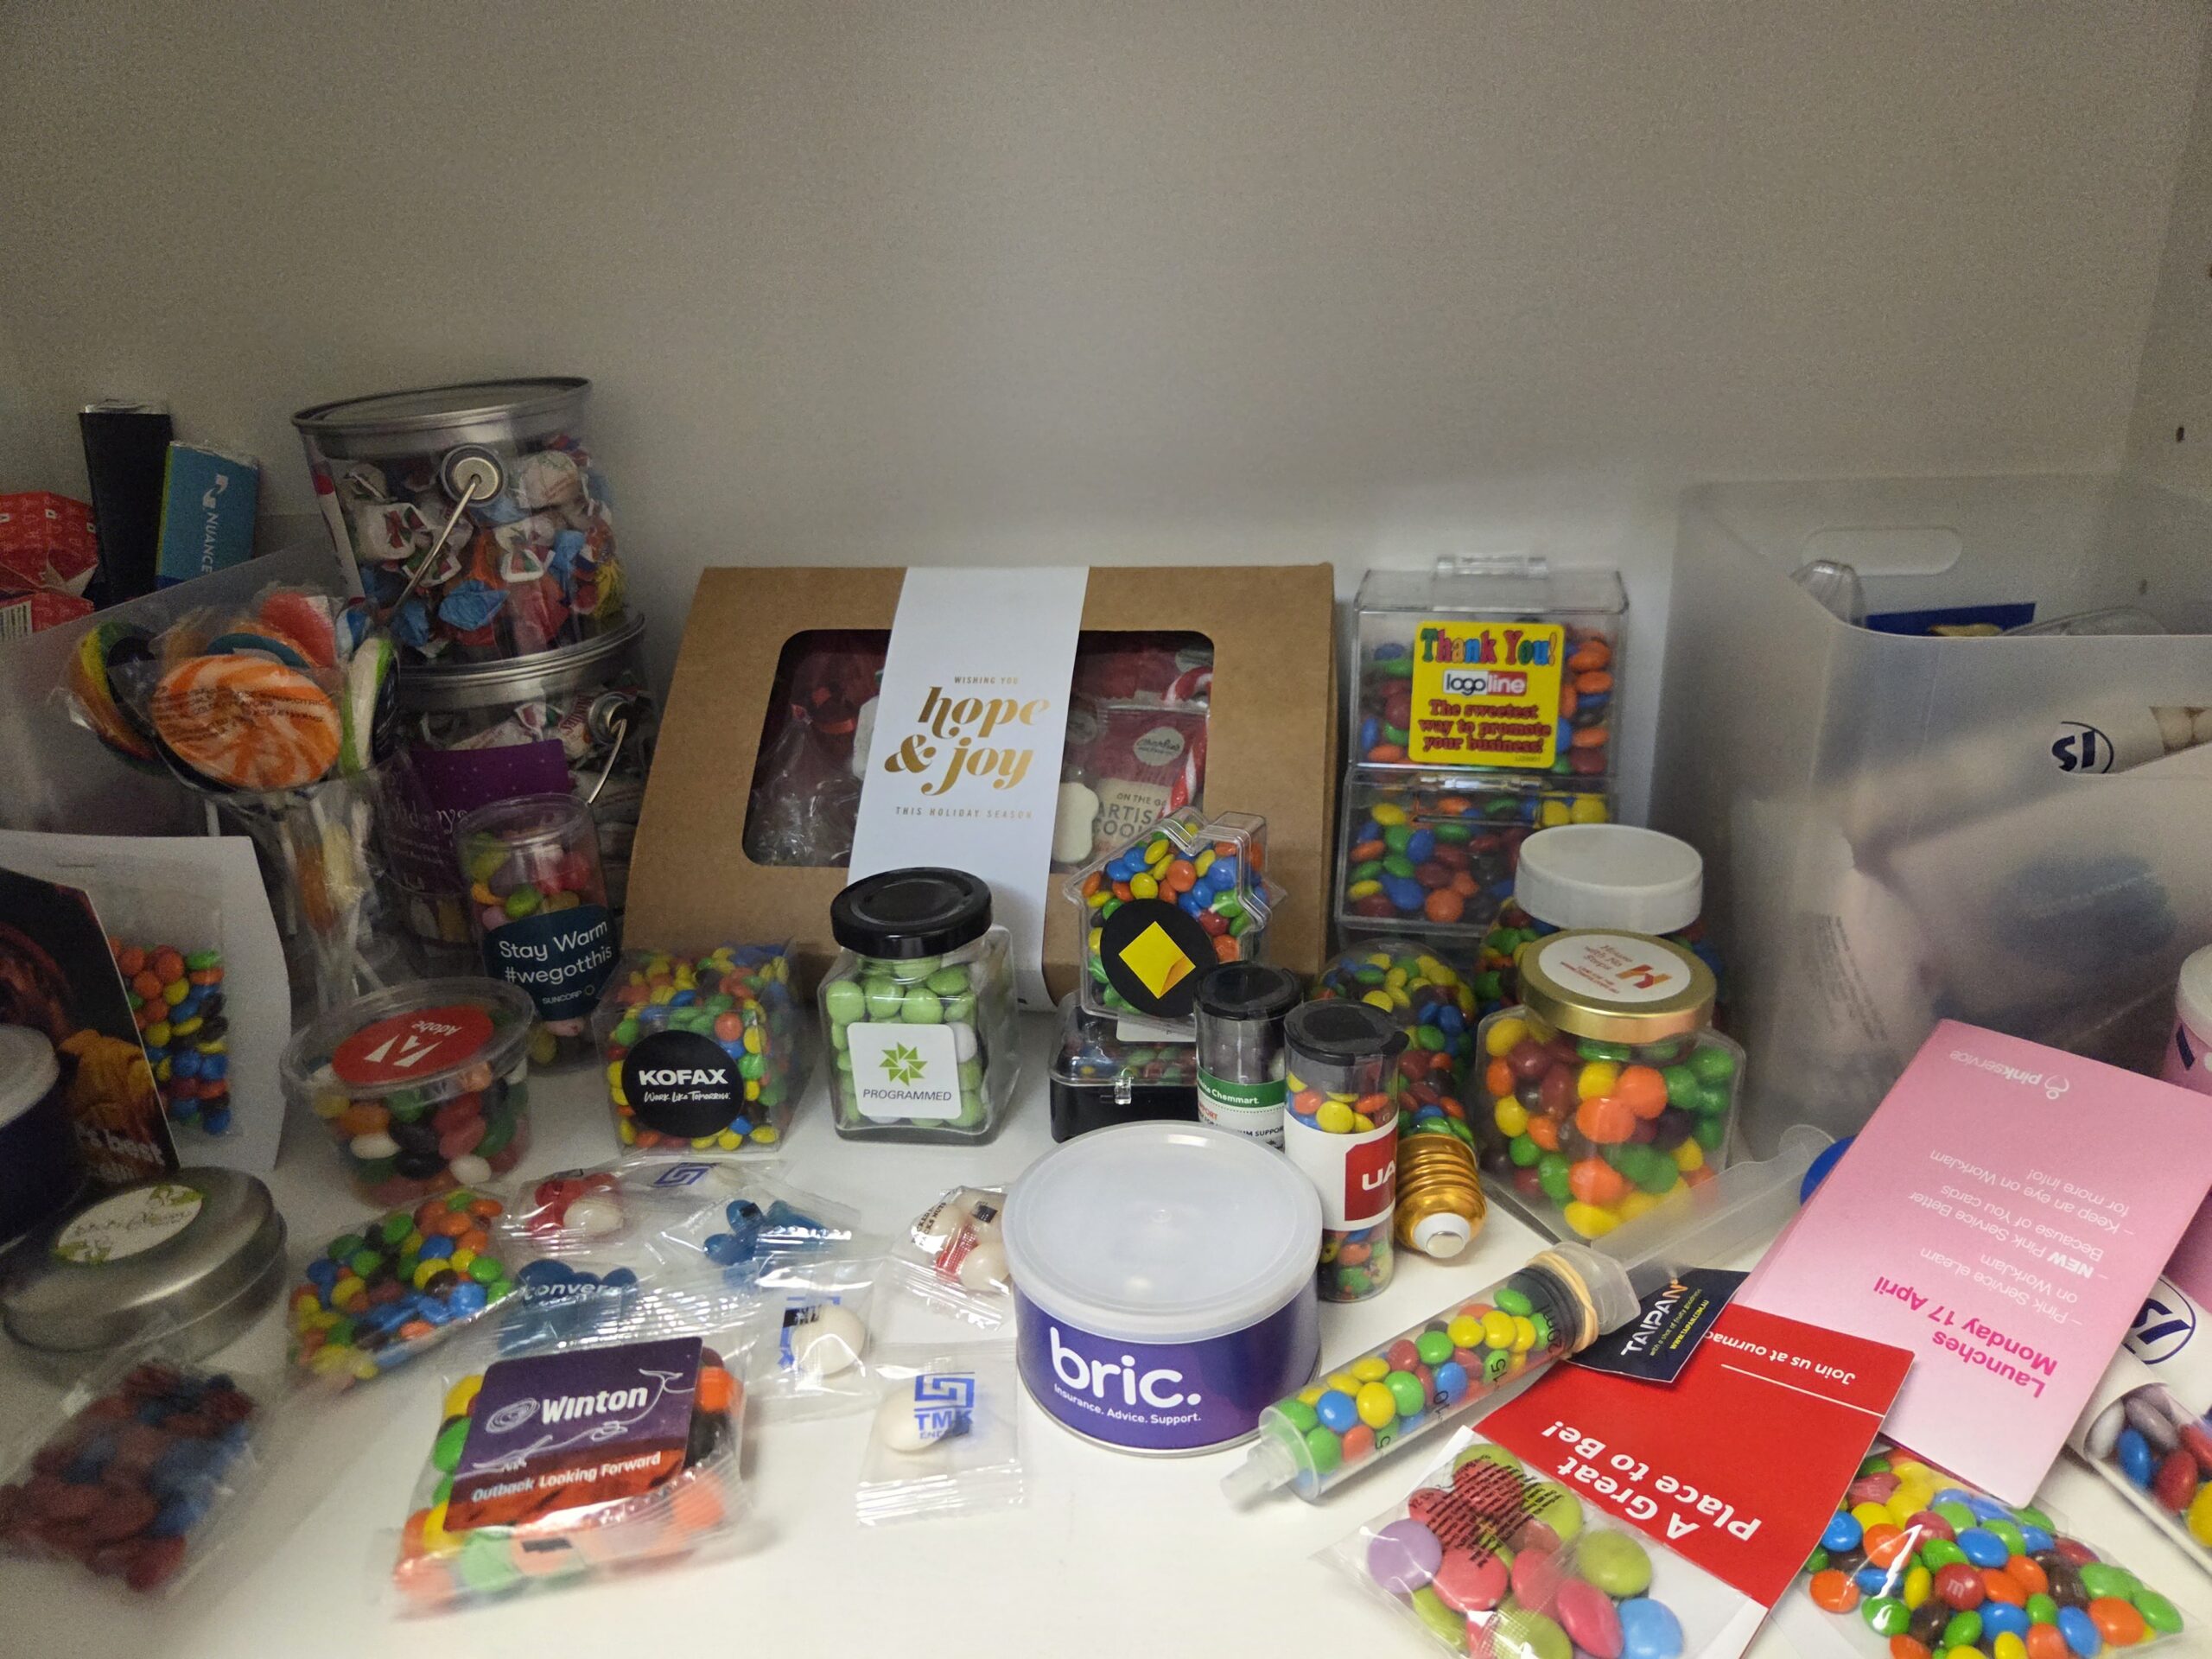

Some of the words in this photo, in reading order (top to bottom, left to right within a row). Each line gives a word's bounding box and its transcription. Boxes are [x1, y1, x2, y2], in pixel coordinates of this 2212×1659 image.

[201, 512, 219, 574] NUANCE
[1421, 628, 1497, 664] Thank
[1503, 630, 1557, 666] You!
[1001, 677, 1020, 685] YOU
[1446, 674, 1526, 696] logoline
[918, 686, 1051, 740] hope
[1428, 699, 1461, 716] The
[1464, 703, 1539, 719] sweetest
[1418, 720, 1454, 736] way
[1457, 719, 1475, 734] to
[1478, 722, 1552, 738] promote
[1423, 736, 1464, 753] your
[884, 734, 937, 773] &
[921, 737, 1034, 796] joy
[1116, 792, 1131, 801] ON
[1133, 794, 1151, 804] THE
[896, 806, 922, 816] THIS
[930, 808, 980, 818] HOLIDAY
[987, 810, 1033, 819] SEASON
[499, 940, 549, 962] Stay
[553, 921, 607, 952] Warm
[505, 945, 613, 985] #wegotthis
[542, 990, 582, 1005] SUNCORP
[411, 1020, 462, 1037] Adobe
[639, 1069, 728, 1085] KOFAX
[1949, 1050, 2043, 1085] pinkservice
[863, 1089, 951, 1101] PROGRAMMED
[1929, 1149, 1996, 1185] WorkJam
[2026, 1168, 2061, 1190] info!
[1941, 1185, 1981, 1207] cards
[2000, 1176, 2020, 1192] on
[2024, 1186, 2050, 1205] eye
[2063, 1182, 2105, 1205] more
[1908, 1191, 1953, 1217] Better
[1986, 1203, 2011, 1224] You
[2054, 1198, 2074, 1213] an
[2108, 1201, 2130, 1217] for
[1955, 1210, 2010, 1242] Service
[2013, 1216, 2031, 1229] of
[2077, 1208, 2120, 1235] Keep
[2012, 1234, 2047, 1258] Pink
[2035, 1224, 2104, 1262] Because
[1920, 1247, 1971, 1277] eLearn
[1980, 1253, 2053, 1296] WorkJam
[2047, 1251, 2094, 1279] NEW
[1873, 1276, 1929, 1311] April
[1974, 1272, 2030, 1306] Service
[2056, 1287, 2078, 1304] on
[1620, 1279, 1688, 1356] TAIPAN
[1928, 1306, 1955, 1326] 17
[2032, 1300, 2069, 1325] Pink
[1769, 1349, 1789, 1363] at
[1961, 1318, 2058, 1376] Monday
[1050, 1326, 1202, 1408] bric.
[1491, 1358, 1508, 1385] 15
[1790, 1356, 1813, 1370] us
[1815, 1362, 1857, 1386] Join
[1932, 1331, 2046, 1398] Launches
[541, 1387, 649, 1425] Winton
[1053, 1383, 1105, 1415] Insurance.
[1107, 1408, 1149, 1424] Advice.
[1150, 1411, 1202, 1426] Support.
[1433, 1390, 1451, 1418] 10
[1376, 1435, 1390, 1451] 5
[1541, 1421, 1607, 1460] Be!
[471, 1478, 534, 1502] Outback
[538, 1466, 597, 1489] Looking
[601, 1451, 662, 1477] Forward
[1610, 1452, 1650, 1484] to
[1557, 1456, 1659, 1520] Great
[1655, 1474, 1762, 1541] Place
[1666, 1511, 1700, 1541] A
